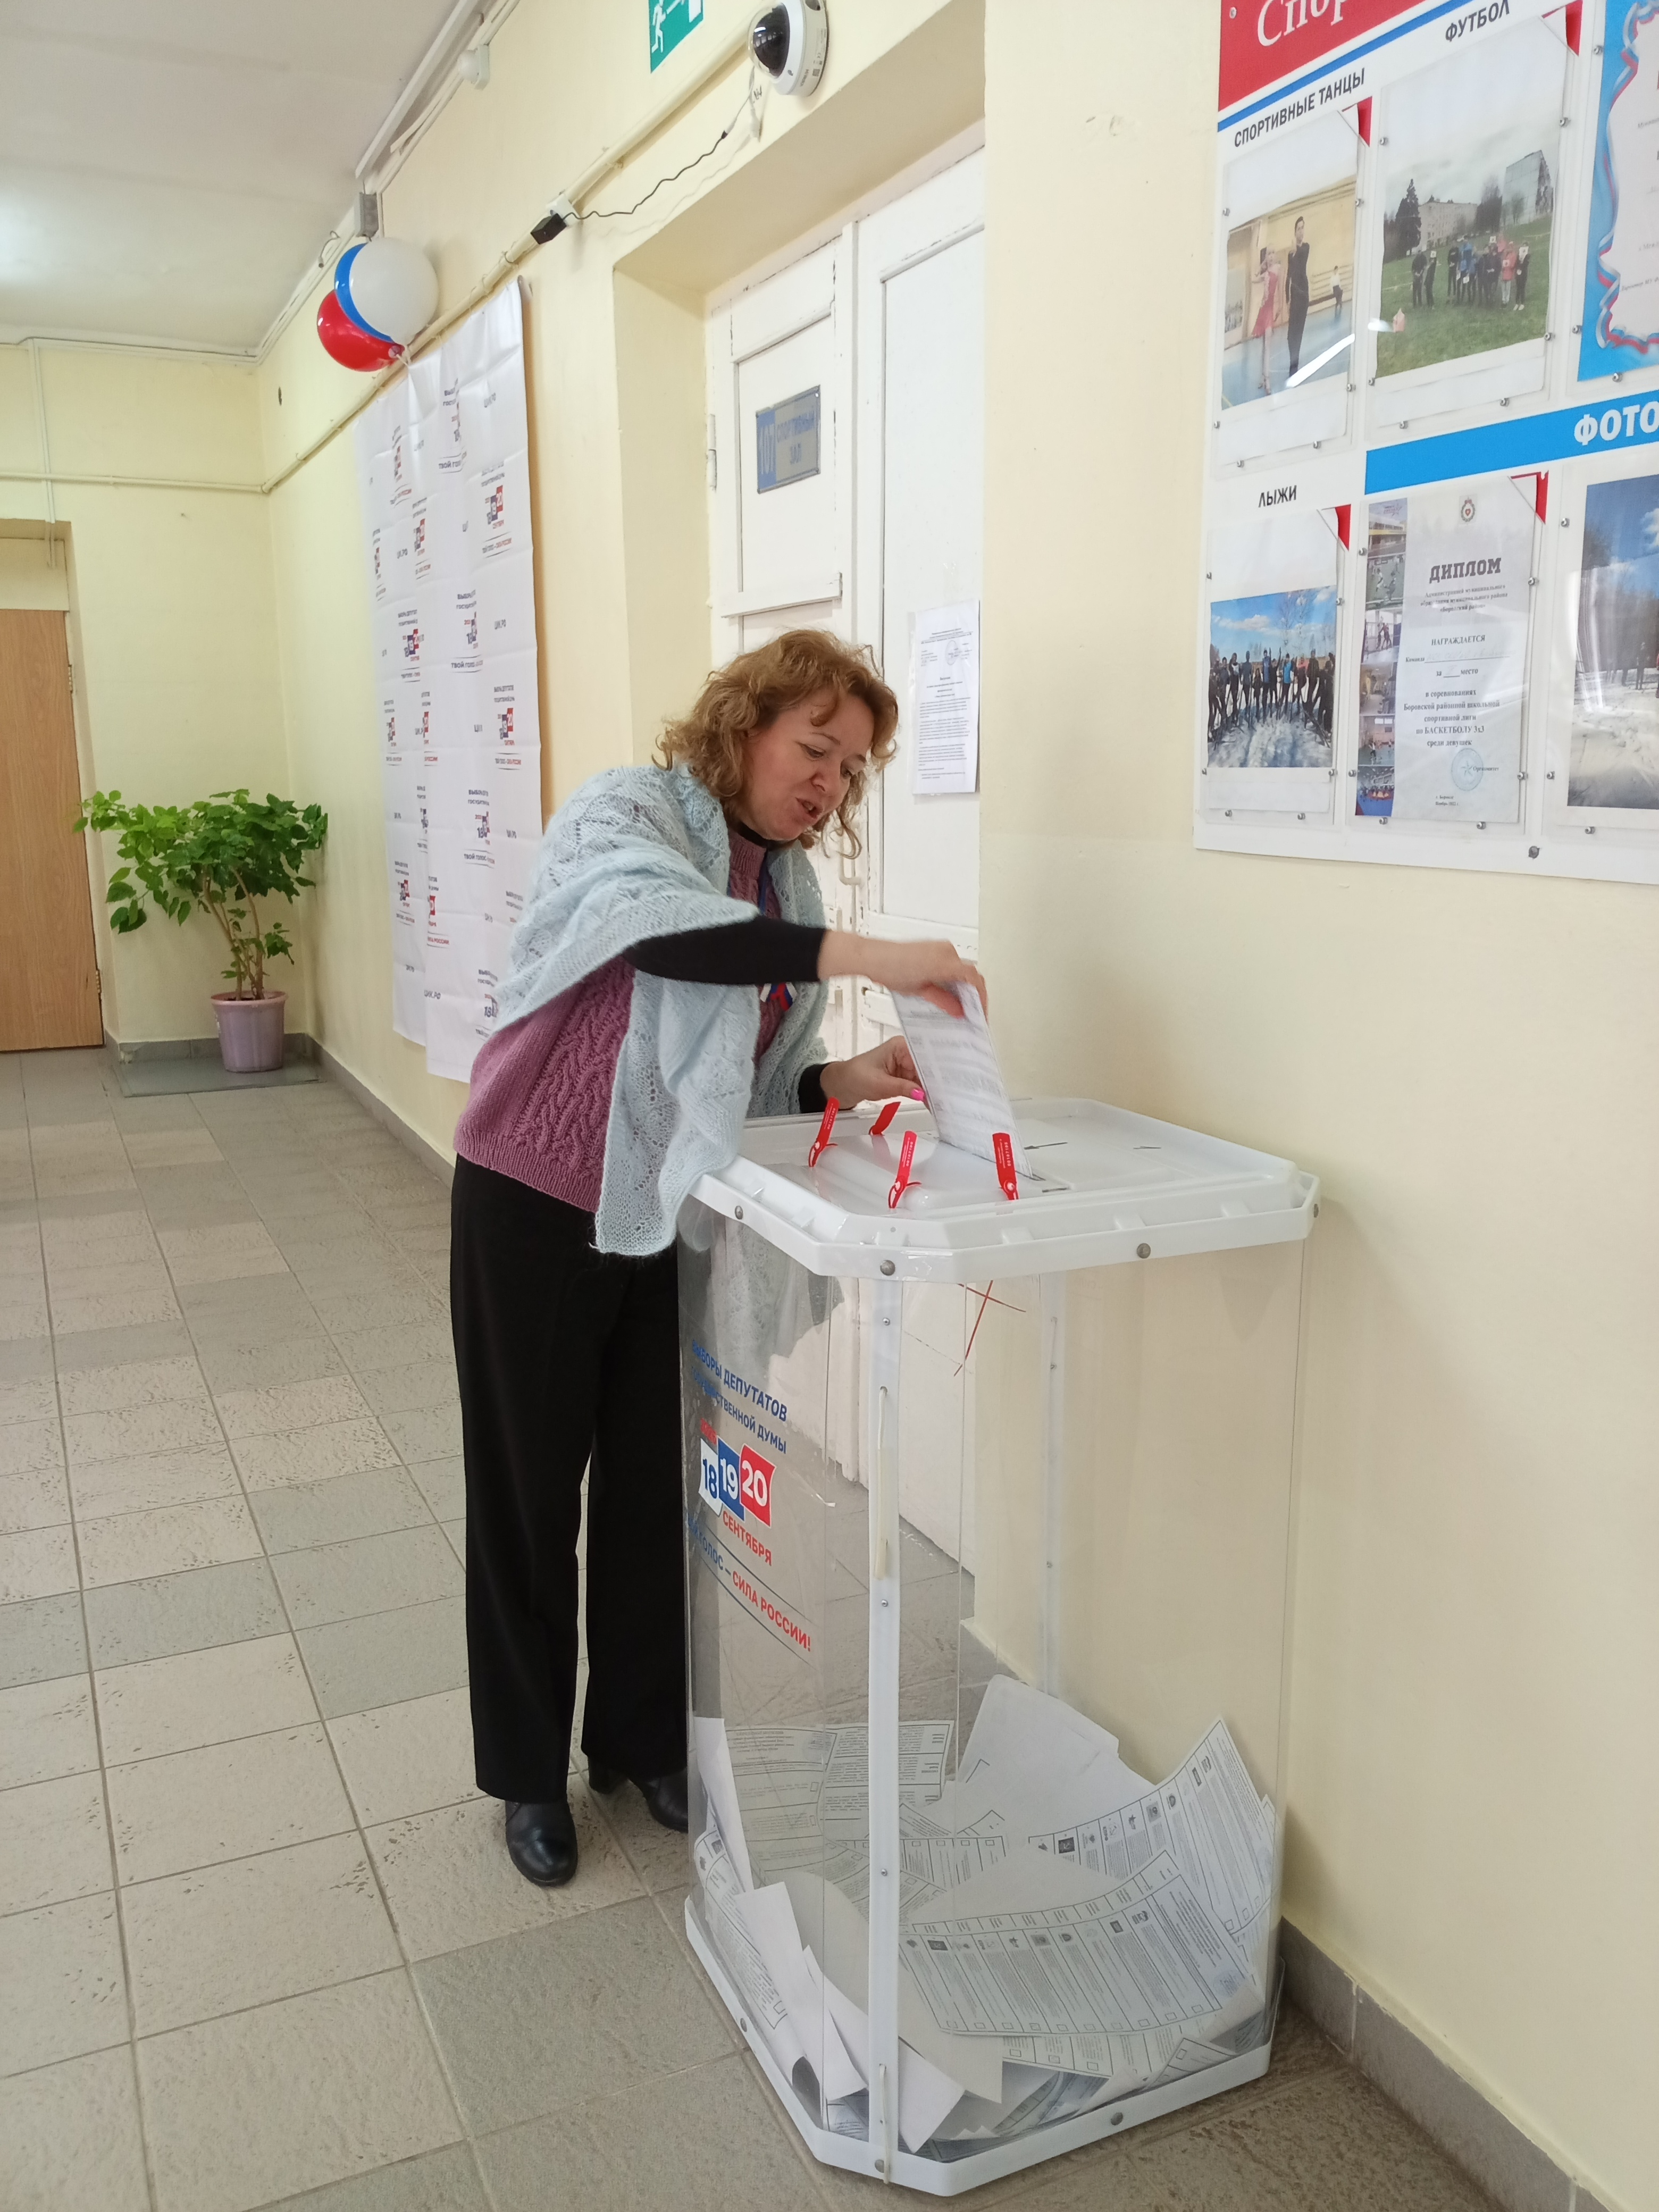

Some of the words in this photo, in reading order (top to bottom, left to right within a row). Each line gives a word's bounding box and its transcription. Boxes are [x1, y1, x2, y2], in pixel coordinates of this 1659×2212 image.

[1445, 0, 1510, 42] ФУТБОЛ
[1235, 93, 1315, 147] СПОРТИВНЫЕ
[1319, 68, 1364, 105] ТАНЦЫ
[1574, 401, 1659, 446] ФОТО
[1258, 484, 1297, 508] ЛЫЖИ
[1429, 558, 1501, 584] ДИПЛОМ
[1431, 635, 1486, 646] НАГРАЖДАЕТСЯ
[1404, 703, 1435, 713] Боровской
[1436, 701, 1465, 711] районной
[1467, 700, 1500, 709] школьной
[1430, 690, 1476, 699] соревнованиях
[1424, 714, 1460, 723] спортивной
[1425, 726, 1472, 735] БАСКЕТБОЛУ
[724, 1369, 787, 1422] ДЕПУТАТОВ
[758, 1424, 786, 1454] ДУМЫ
[703, 1458, 717, 1499] 18
[720, 1457, 739, 1500] 19
[742, 1460, 767, 1506] 20
[723, 1511, 772, 1566] СЕНТЯБРЯ
[733, 1571, 758, 1607] СИЛА
[761, 1596, 811, 1652] РОССИИ!
